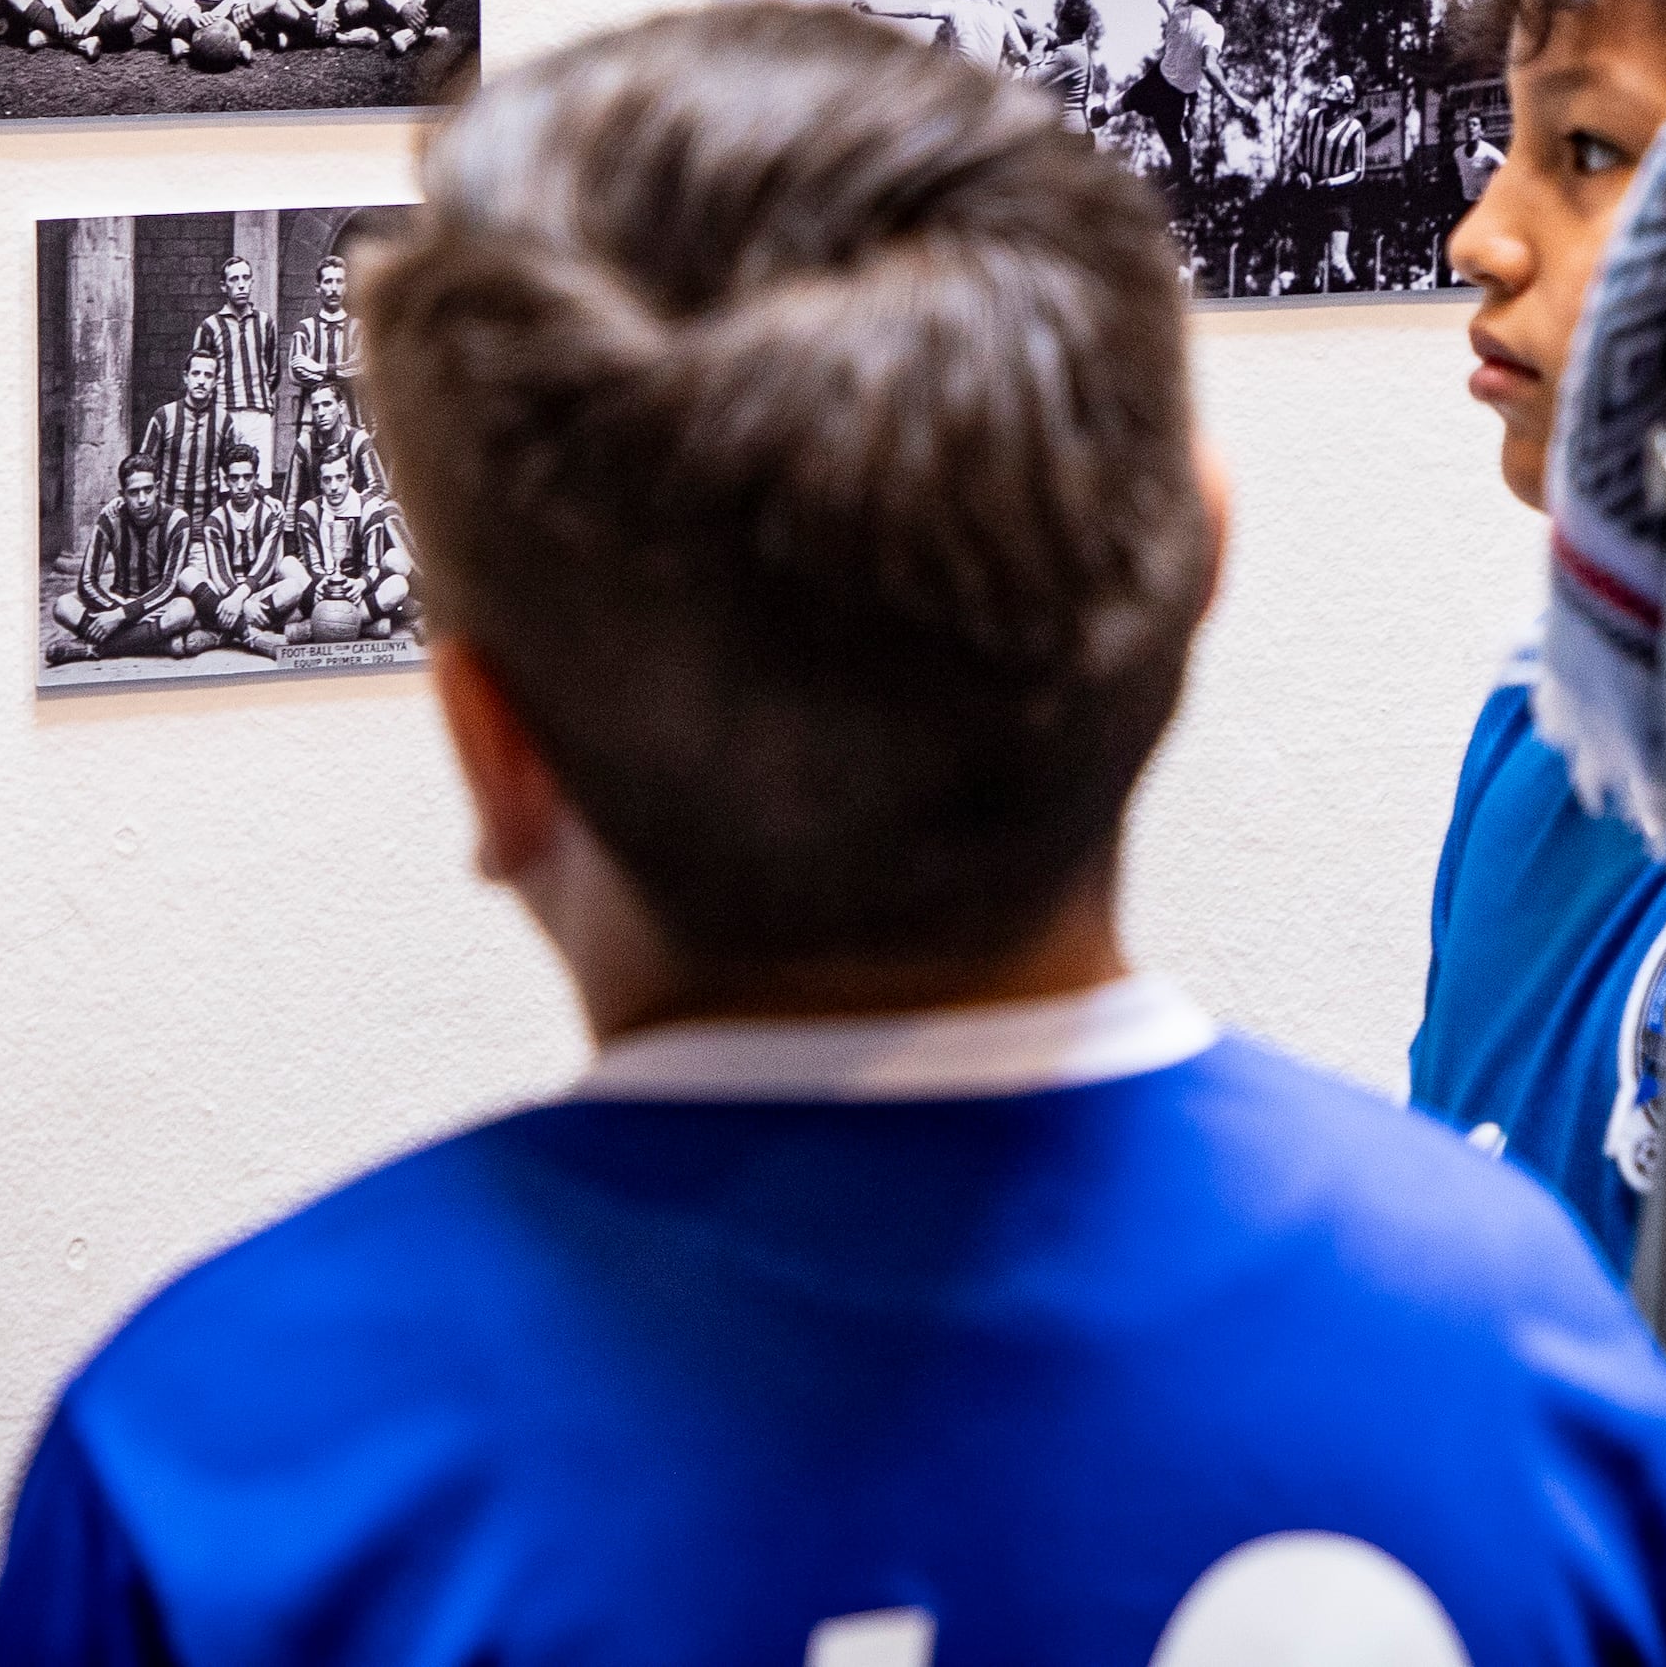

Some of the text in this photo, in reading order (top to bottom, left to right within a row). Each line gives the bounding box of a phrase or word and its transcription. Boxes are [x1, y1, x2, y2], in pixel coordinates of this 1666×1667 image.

[282, 645, 333, 658] FOOT-BALL
[352, 642, 407, 654] CATALUNYA
[294, 658, 322, 669] EQUIP
[326, 656, 362, 666] PRIMER
